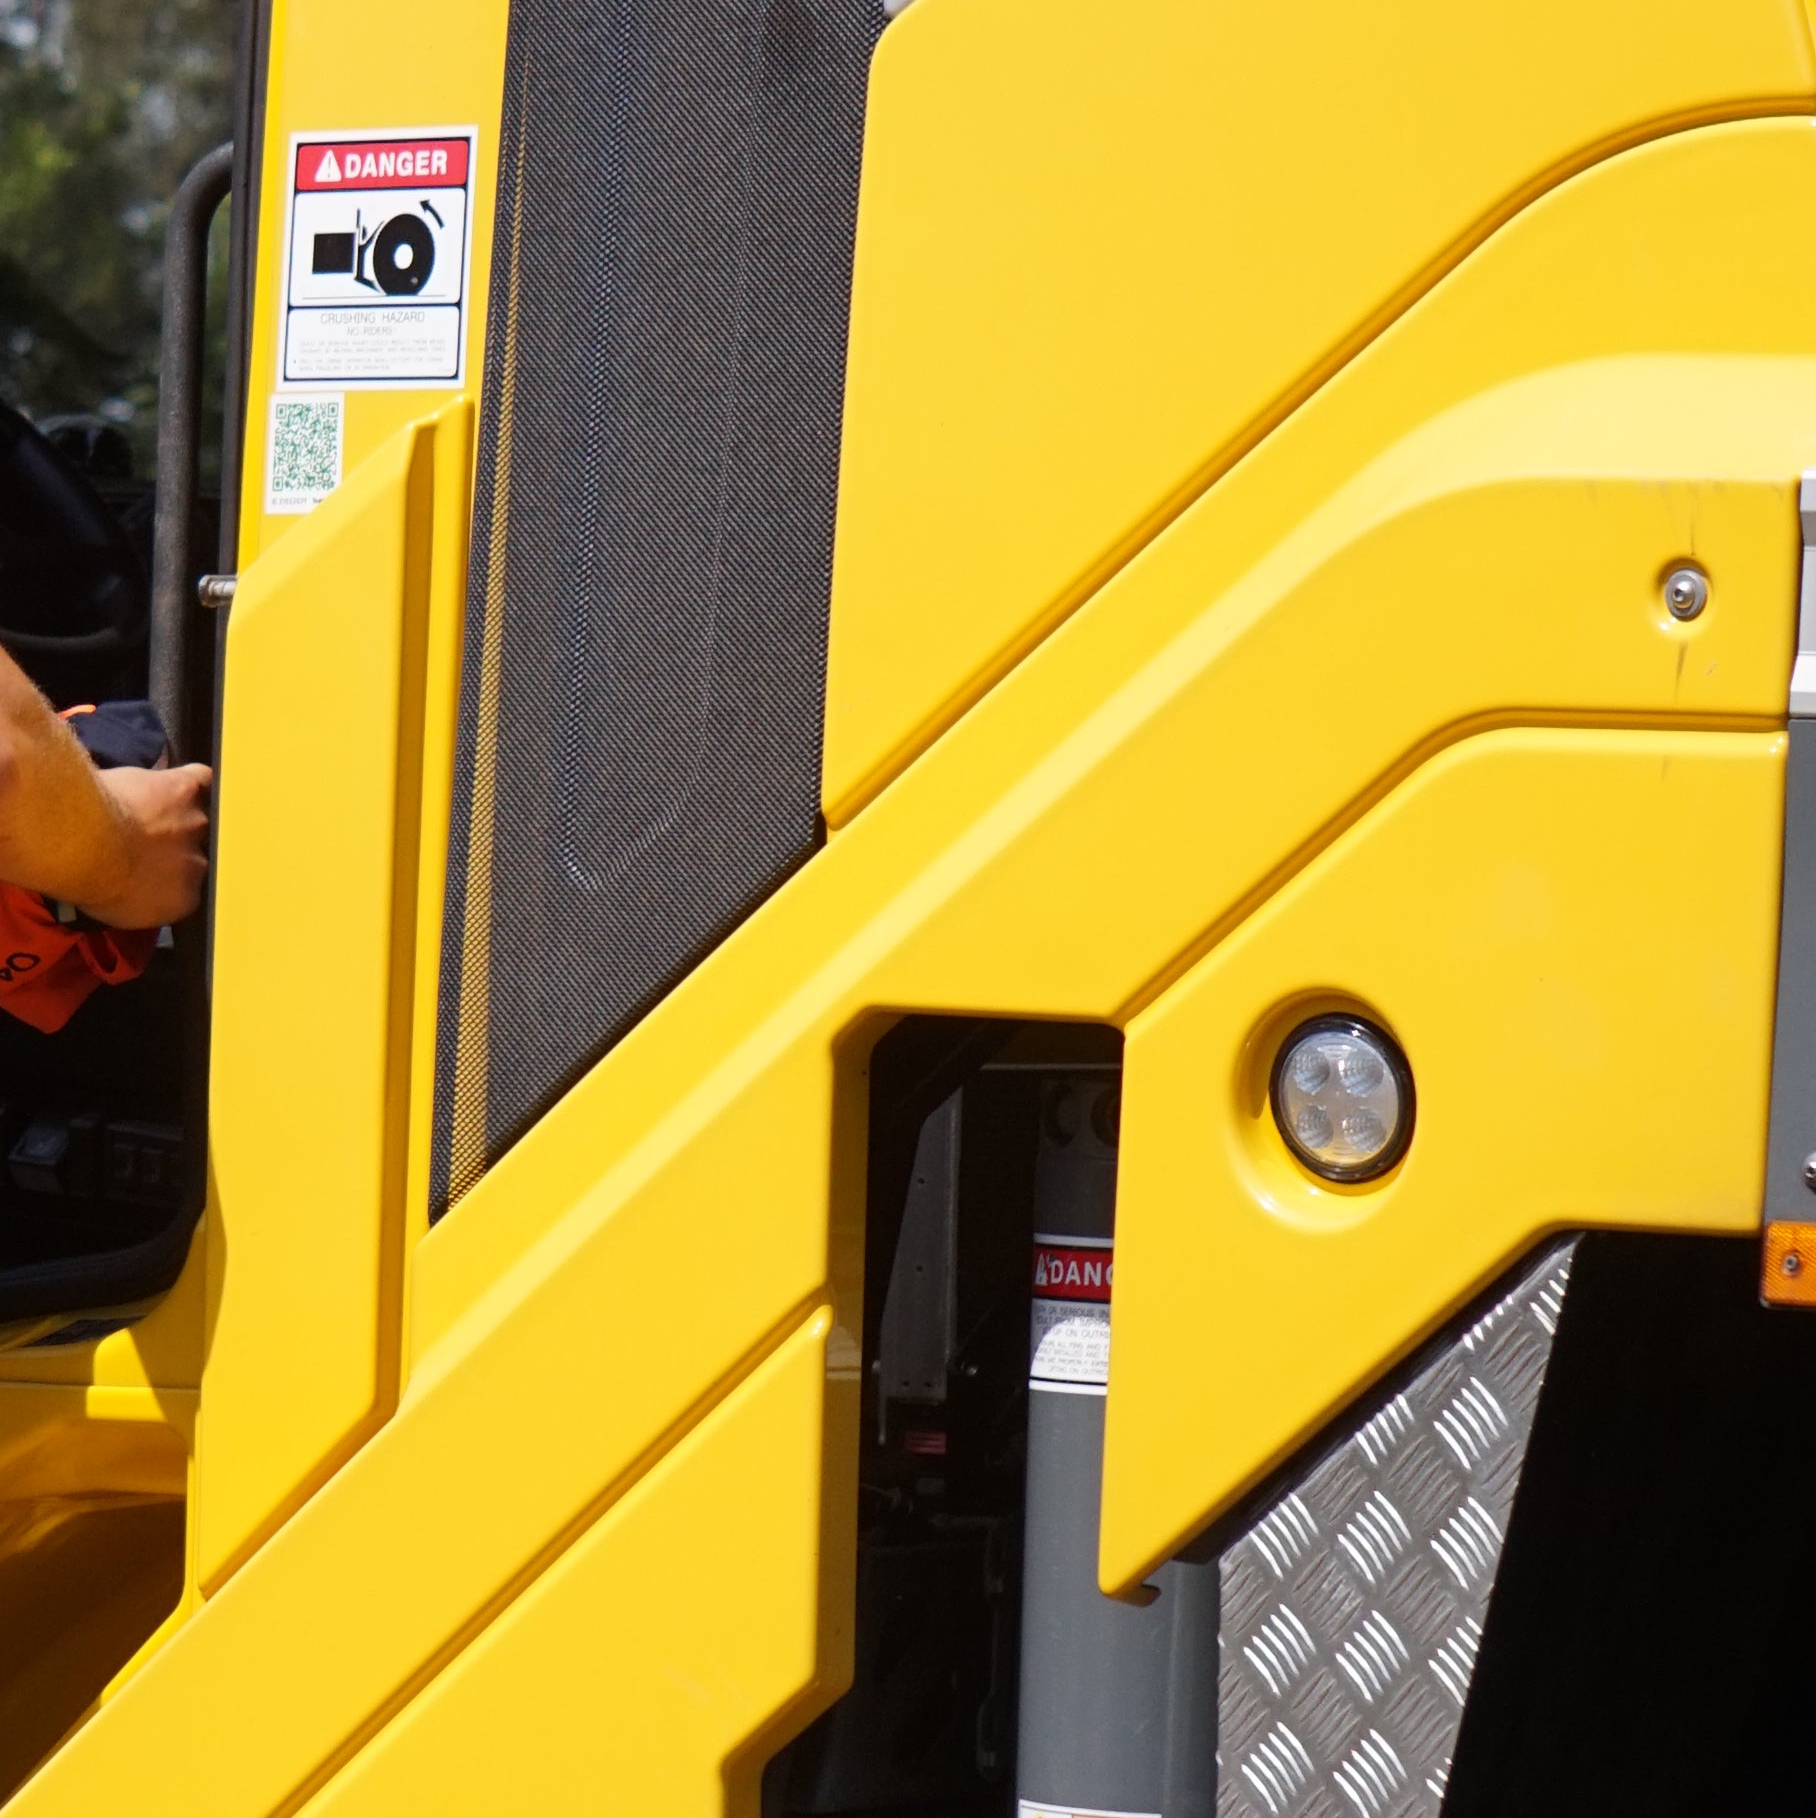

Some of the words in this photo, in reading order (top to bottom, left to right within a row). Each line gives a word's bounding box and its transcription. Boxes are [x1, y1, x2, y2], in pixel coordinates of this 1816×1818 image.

[345, 150, 448, 179] DANGER
[320, 312, 376, 325] CRUSHING
[382, 311, 425, 324] HAZARD
